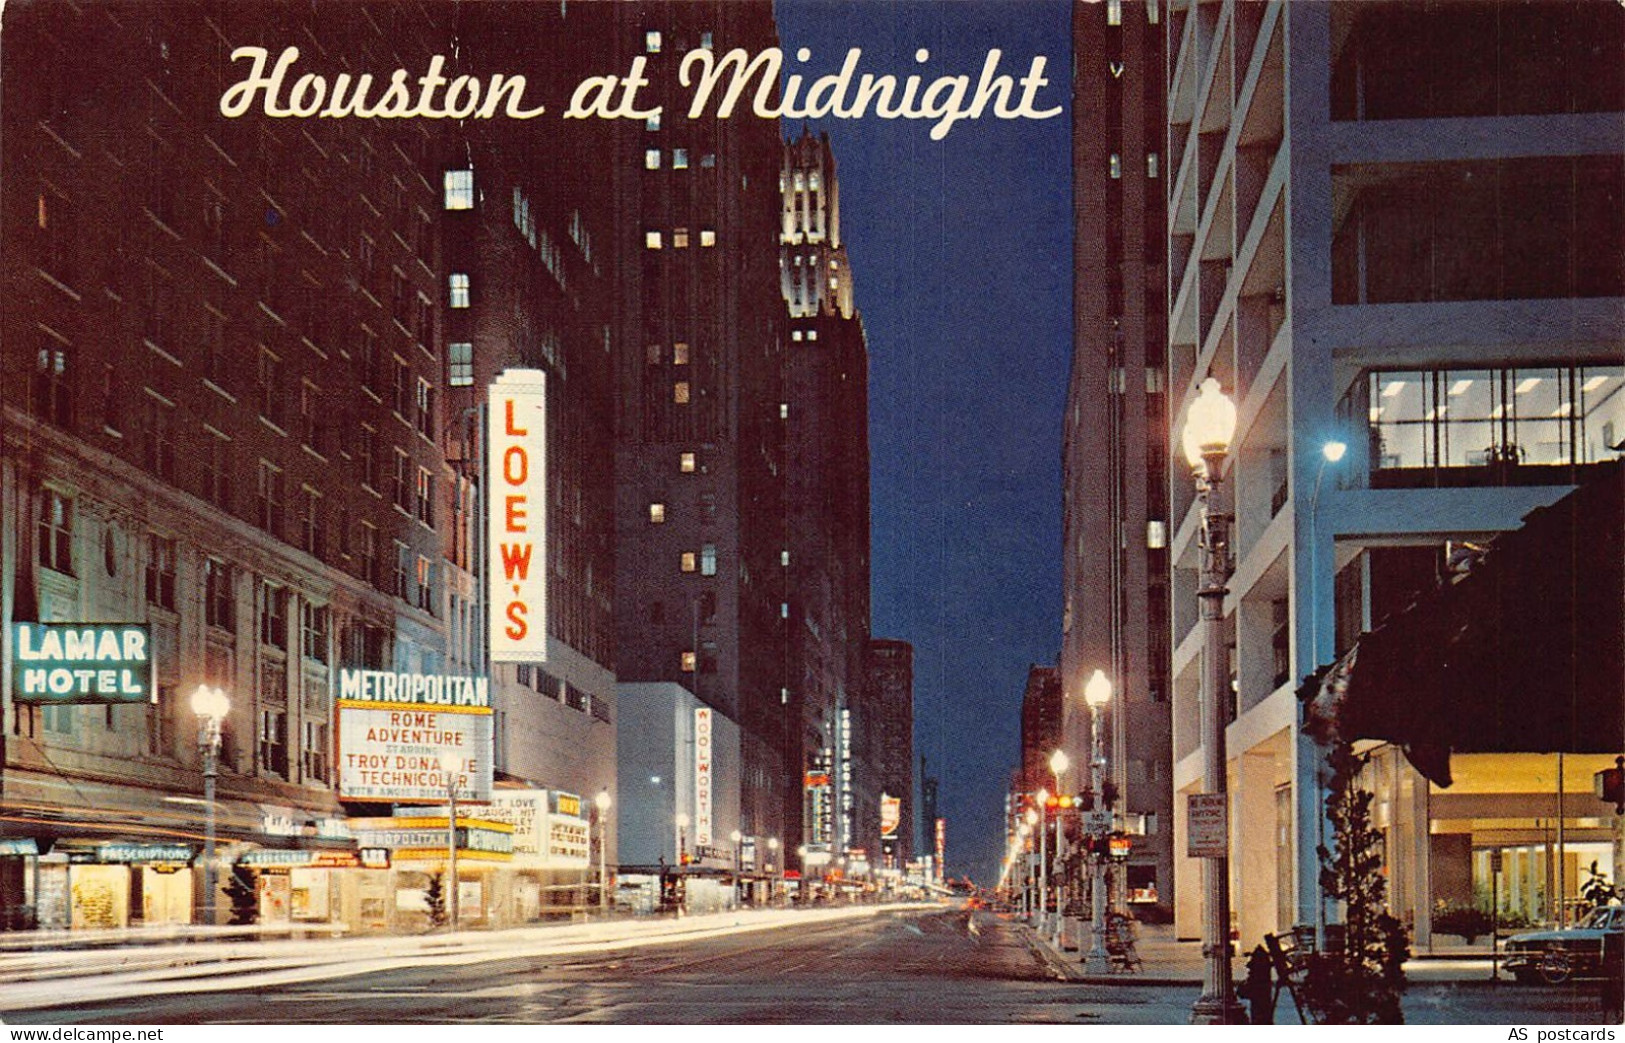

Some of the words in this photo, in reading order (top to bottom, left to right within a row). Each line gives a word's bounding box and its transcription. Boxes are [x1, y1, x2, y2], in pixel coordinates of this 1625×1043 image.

[499, 397, 533, 641] LOEW'S
[19, 626, 146, 661] LAMAR
[24, 668, 142, 694] HOTEL
[340, 668, 489, 707] METROPOLITAN
[391, 712, 437, 729] ROME
[366, 728, 464, 747] ADVENTURE
[346, 753, 389, 769] TROY
[396, 756, 478, 773] DONAE
[359, 770, 468, 788] TECHNICOLR
[698, 710, 709, 844] WOOLWORTHS
[477, 808, 513, 818] LAUGH
[520, 809, 536, 817] HIT
[511, 799, 535, 808] LOVE
